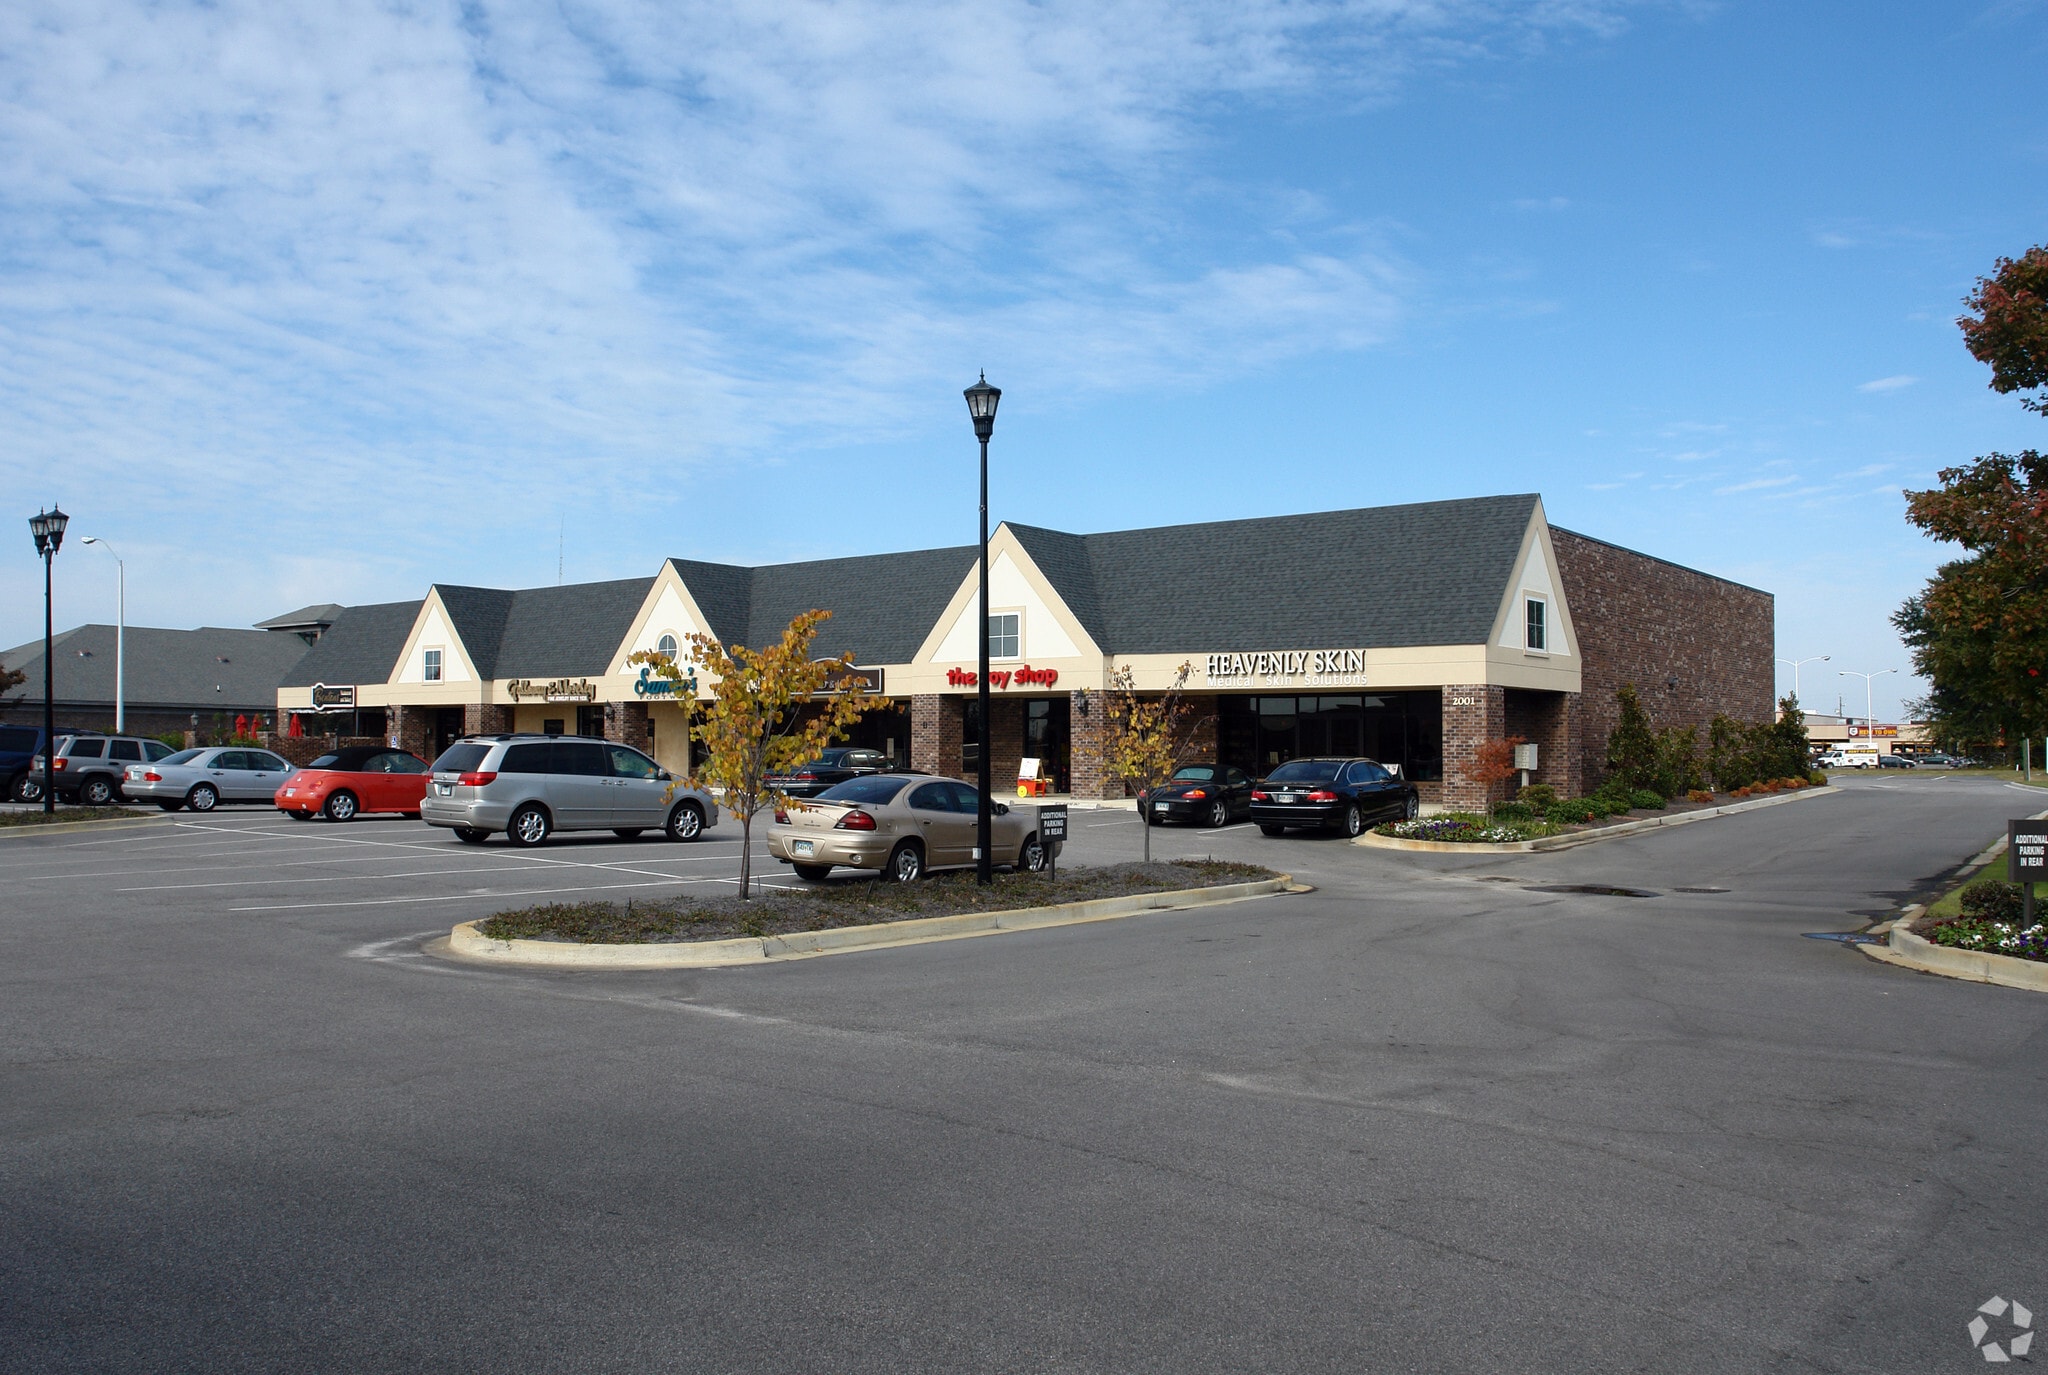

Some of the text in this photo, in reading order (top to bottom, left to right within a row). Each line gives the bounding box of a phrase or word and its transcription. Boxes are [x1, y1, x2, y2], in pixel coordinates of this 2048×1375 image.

[1205, 650, 1366, 676] HEAVENLY SKIN
[946, 664, 1058, 689] the oy shop
[1207, 674, 1367, 687] Medical Skin Solutions
[1453, 697, 1475, 705] 2001
[2015, 835, 2048, 844] ADDITIONAL
[2019, 846, 2044, 855] PARKING
[2020, 857, 2043, 866] IN REAR
